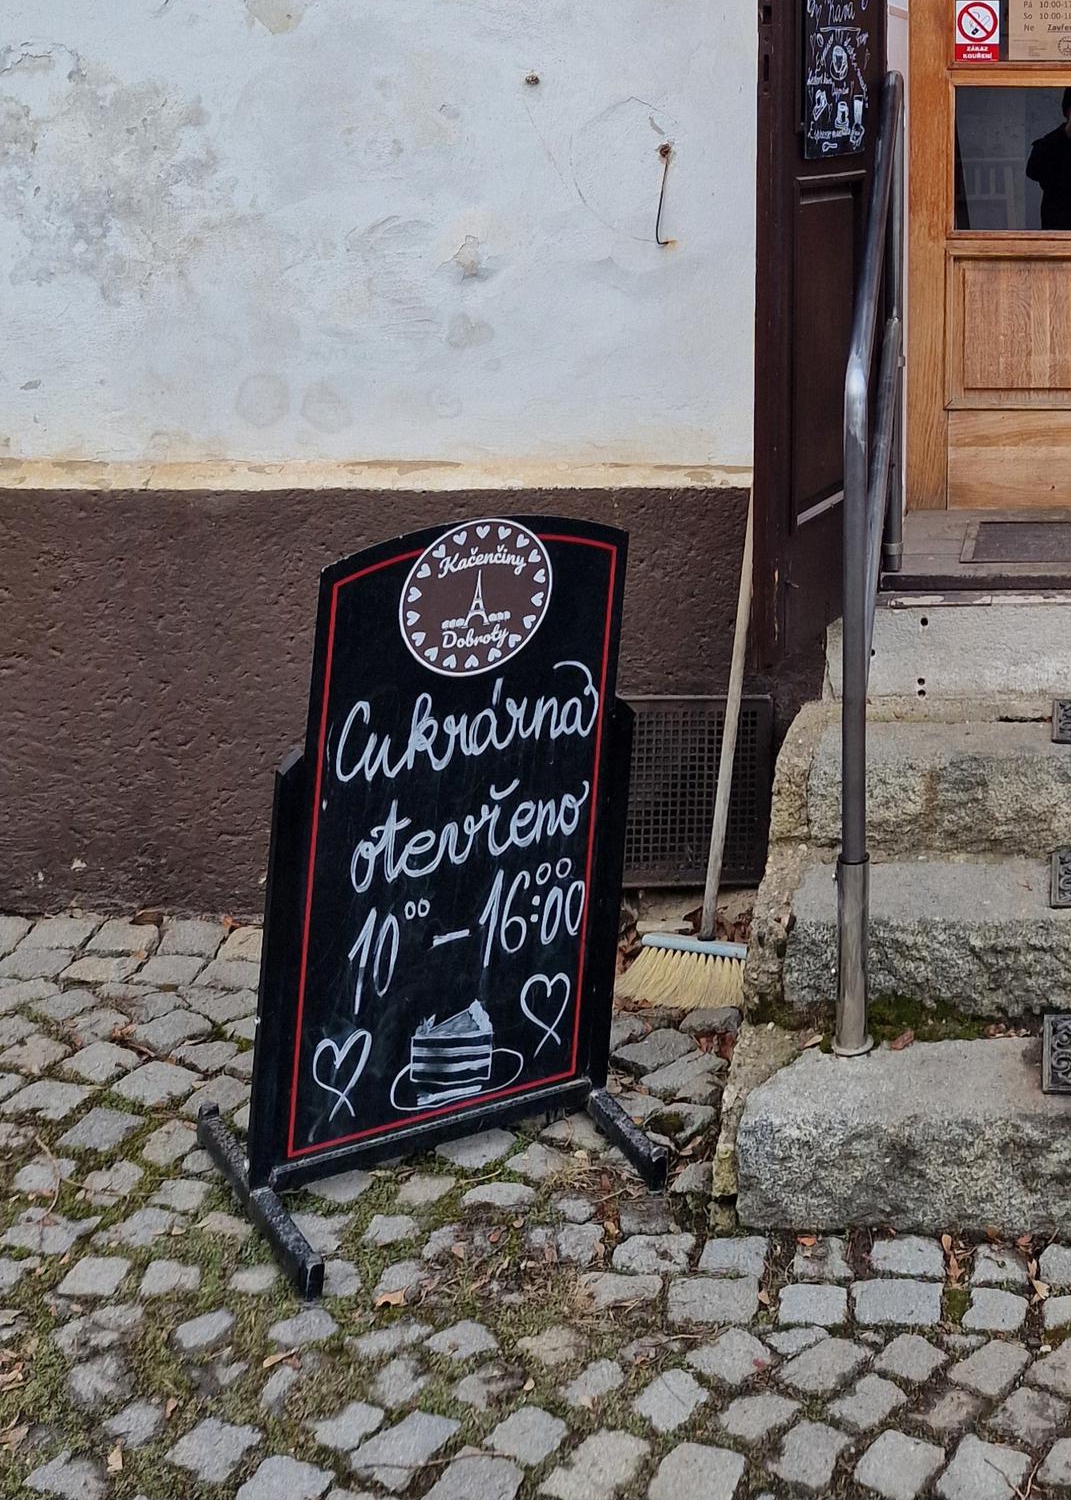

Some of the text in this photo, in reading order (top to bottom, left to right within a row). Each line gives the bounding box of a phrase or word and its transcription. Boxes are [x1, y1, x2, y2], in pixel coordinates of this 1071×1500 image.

[1023, 12, 1033, 20] So
[1024, 24, 1035, 32] Ne
[438, 544, 527, 579] Kačenčiny
[442, 624, 508, 648] Dobroty
[335, 660, 600, 782] Cukrárna
[351, 778, 590, 893] otevřeno
